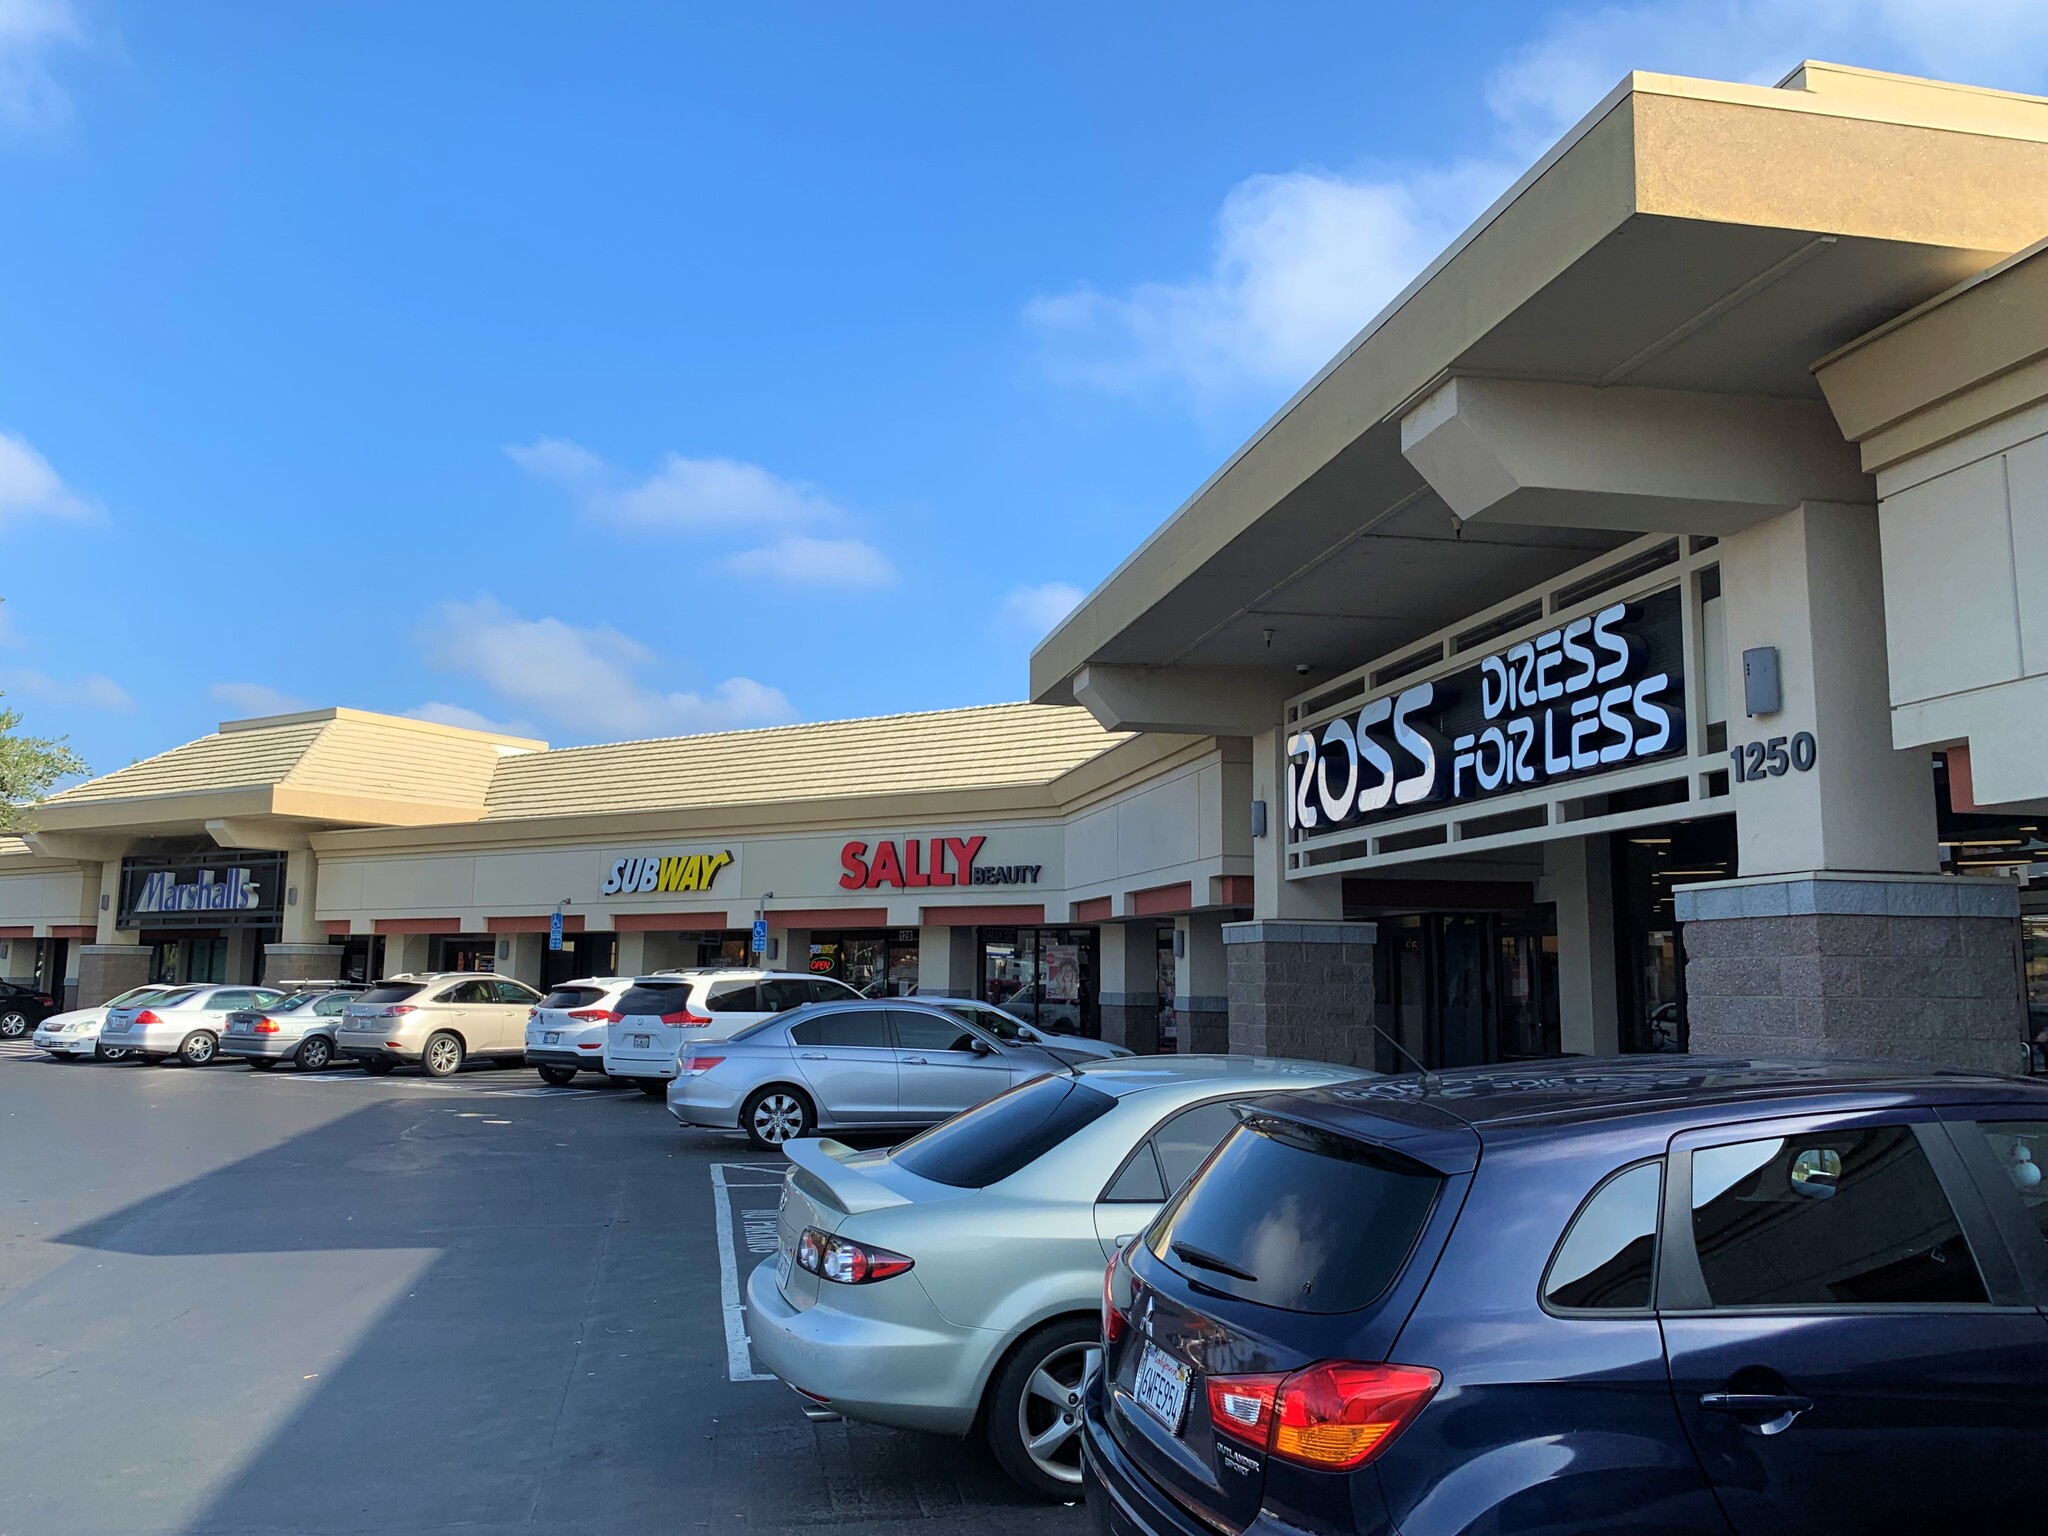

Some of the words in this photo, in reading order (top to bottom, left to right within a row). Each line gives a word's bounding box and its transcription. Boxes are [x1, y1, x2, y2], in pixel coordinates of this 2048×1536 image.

[1481, 603, 1629, 720] DRESS
[1287, 682, 1436, 829] ROSS
[1454, 716, 1535, 798] FOR
[1545, 673, 1670, 775] LESS
[1730, 731, 1817, 783] 1250
[601, 850, 733, 895] SUBWAY
[839, 836, 986, 890] SALLY
[974, 865, 1041, 885] BEAUTY
[134, 868, 259, 912] Marshalls
[811, 960, 831, 970] OPEN
[1216, 1442, 1260, 1472] OUTLANDER
[1224, 1457, 1250, 1477] SPORT
